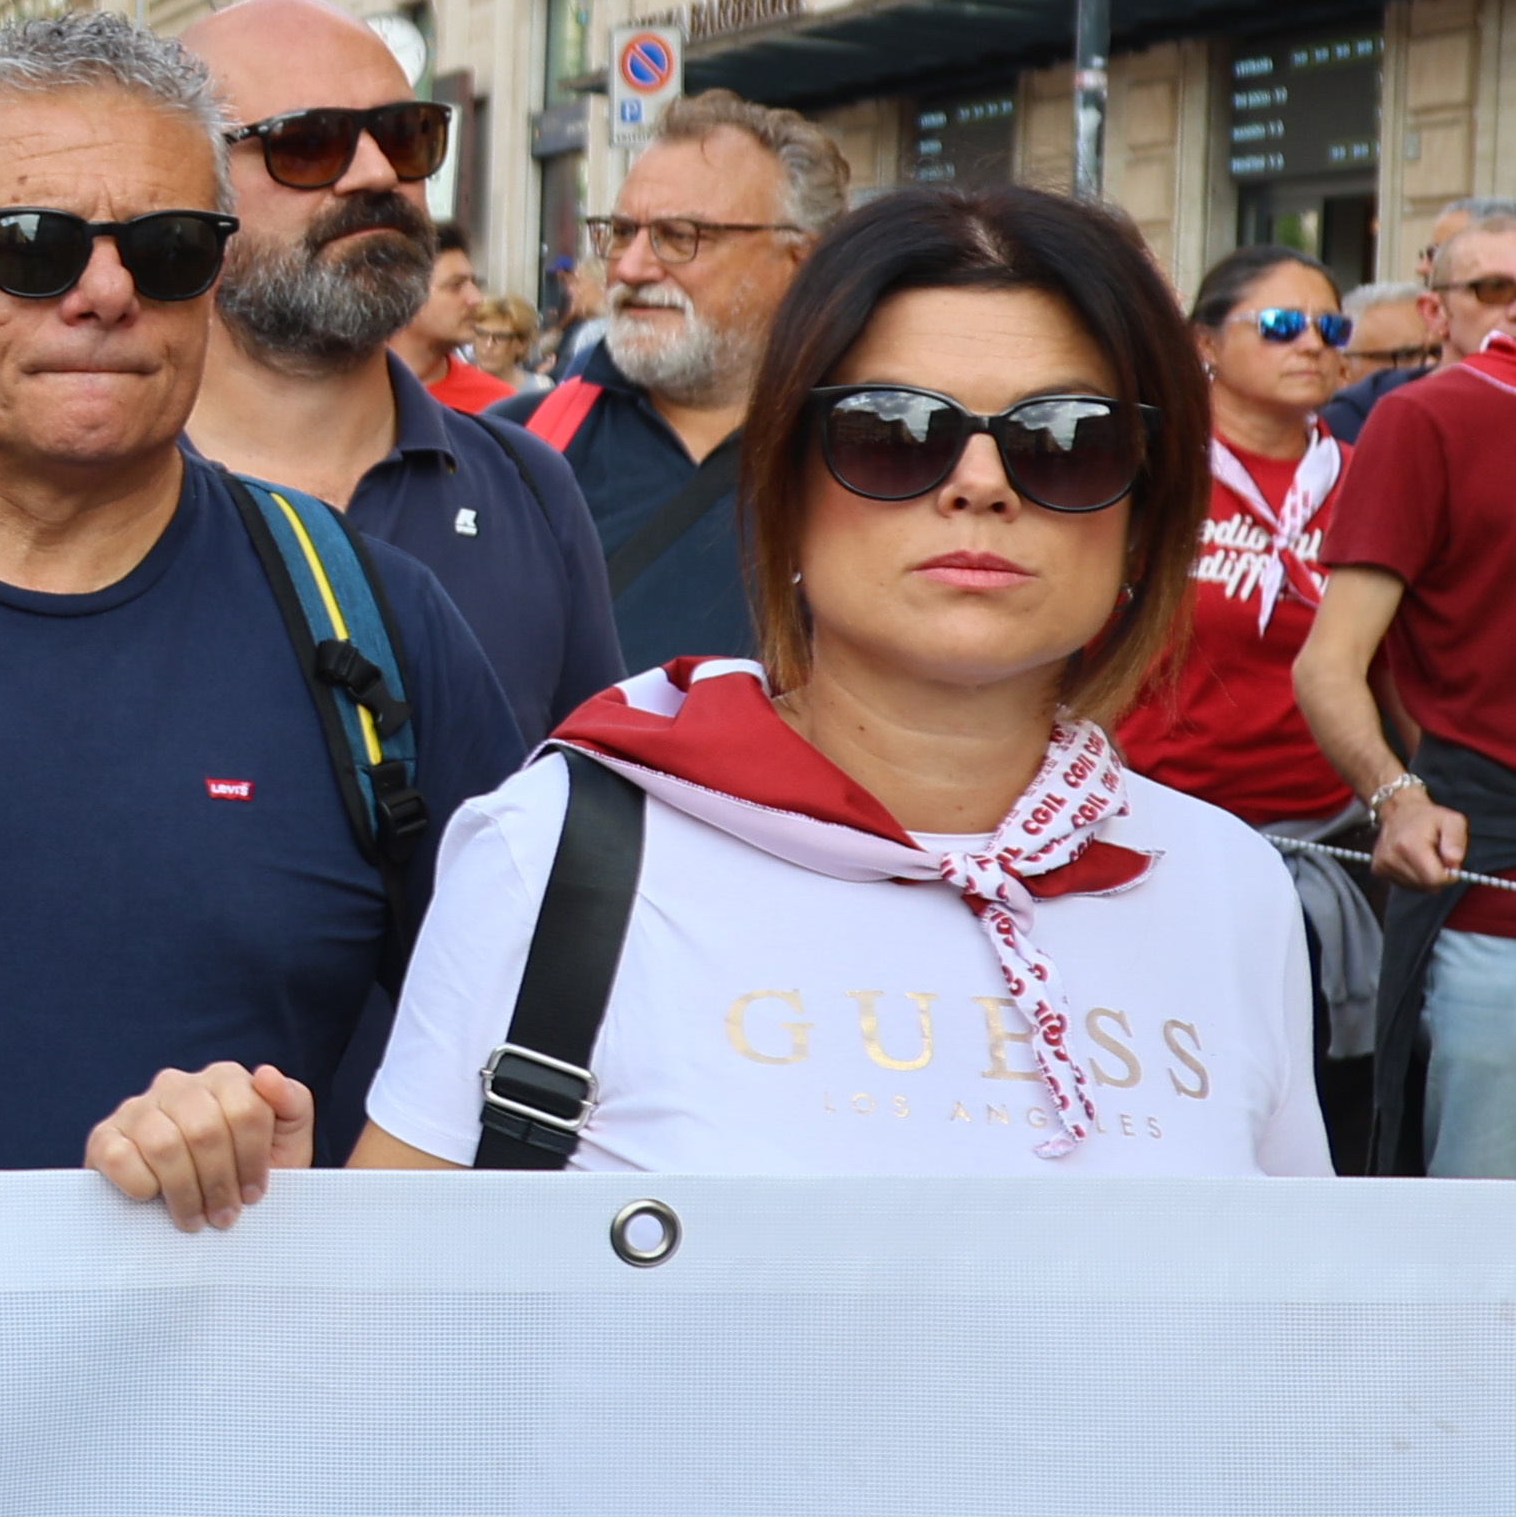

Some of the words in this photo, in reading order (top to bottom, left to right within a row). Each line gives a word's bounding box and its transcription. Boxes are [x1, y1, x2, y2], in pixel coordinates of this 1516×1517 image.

[1062, 753, 1097, 789] CGIL
[1021, 792, 1068, 836] CGIL
[1070, 792, 1111, 830] CGIL
[723, 988, 1210, 1100] GUESS
[823, 1090, 911, 1119] LOS
[949, 1099, 1164, 1140] ANGLES
